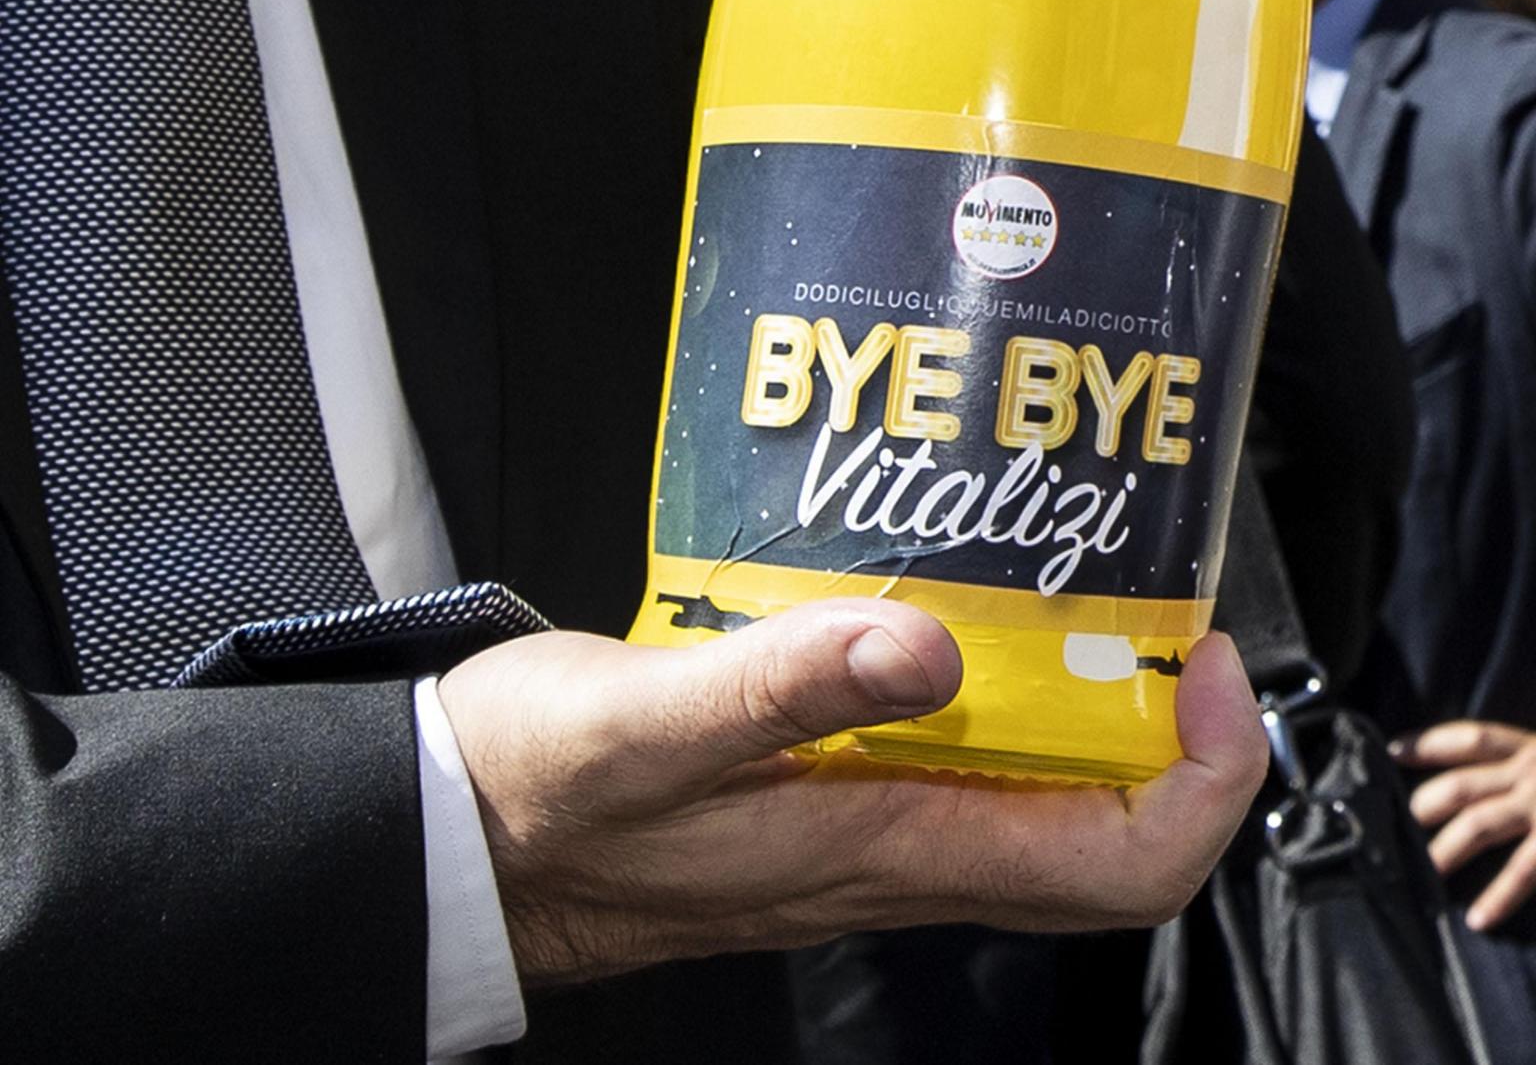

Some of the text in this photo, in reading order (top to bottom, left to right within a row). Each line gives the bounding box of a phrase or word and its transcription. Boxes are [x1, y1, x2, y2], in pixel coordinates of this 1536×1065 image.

[741, 313, 1201, 466] BYE BYE
[796, 423, 1137, 596] Vitalizi
